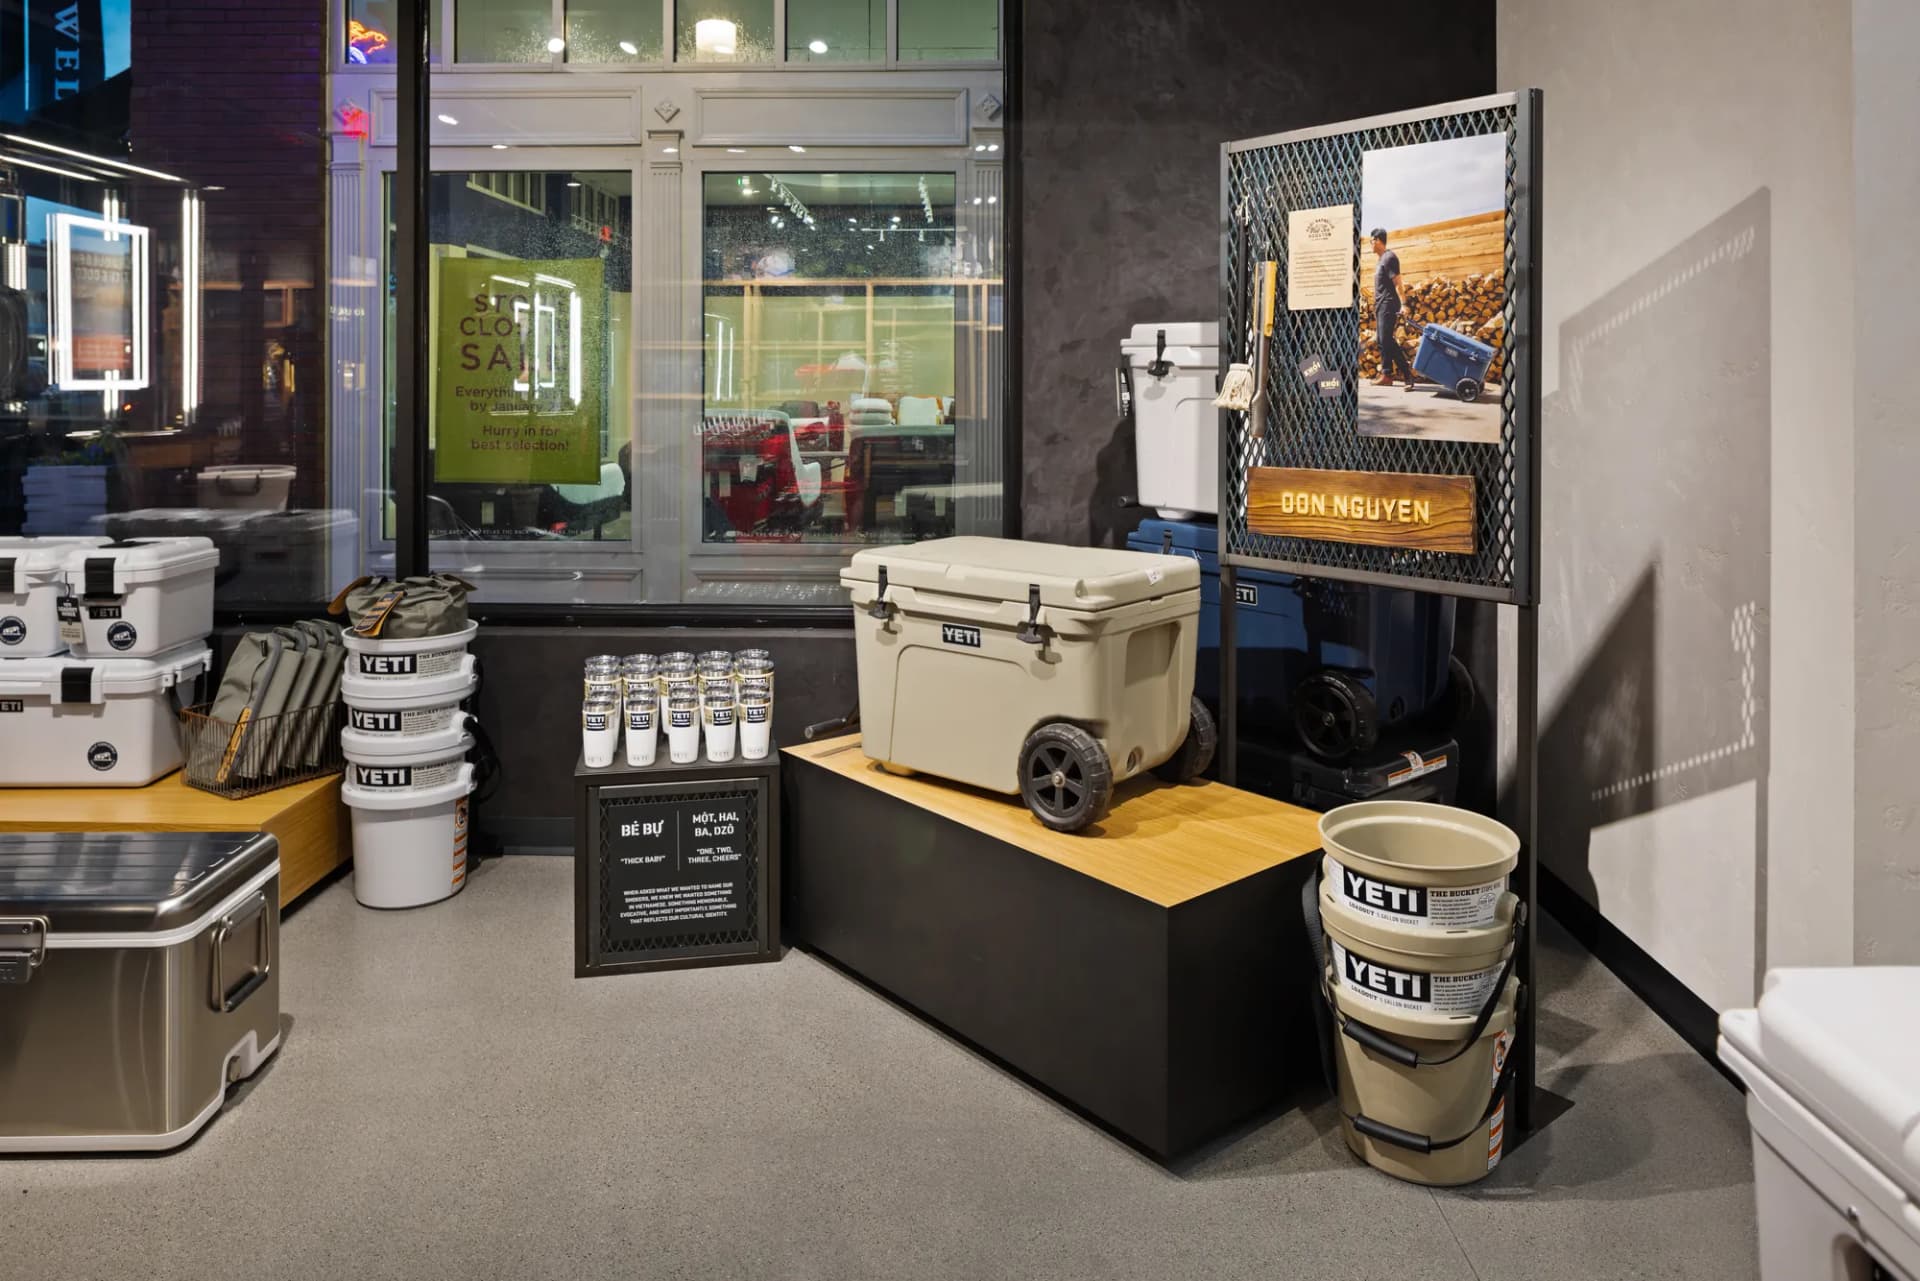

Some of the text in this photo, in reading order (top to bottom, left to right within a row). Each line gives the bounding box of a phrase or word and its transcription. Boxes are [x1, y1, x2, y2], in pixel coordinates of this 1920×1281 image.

[482, 425, 560, 437] Hurry in for
[471, 438, 569, 450] best selection!
[1282, 491, 1430, 524] DON NGUYEN
[1236, 587, 1254, 602] ETI
[92, 608, 119, 617] YETI
[944, 627, 978, 645] YETI
[362, 656, 411, 672] YETI
[0, 701, 21, 711] ETI
[353, 711, 396, 729] YETI
[358, 768, 405, 784] YETI
[719, 811, 740, 822] HAI,
[643, 819, 664, 838] BỰ
[694, 823, 735, 837] BA, DZÔ
[1347, 871, 1418, 913] YETI
[1449, 887, 1480, 897] BUCKET
[668, 899, 696, 907] SOMETHING
[1349, 956, 1421, 998] YETI
[1452, 972, 1482, 983] BUCKET
